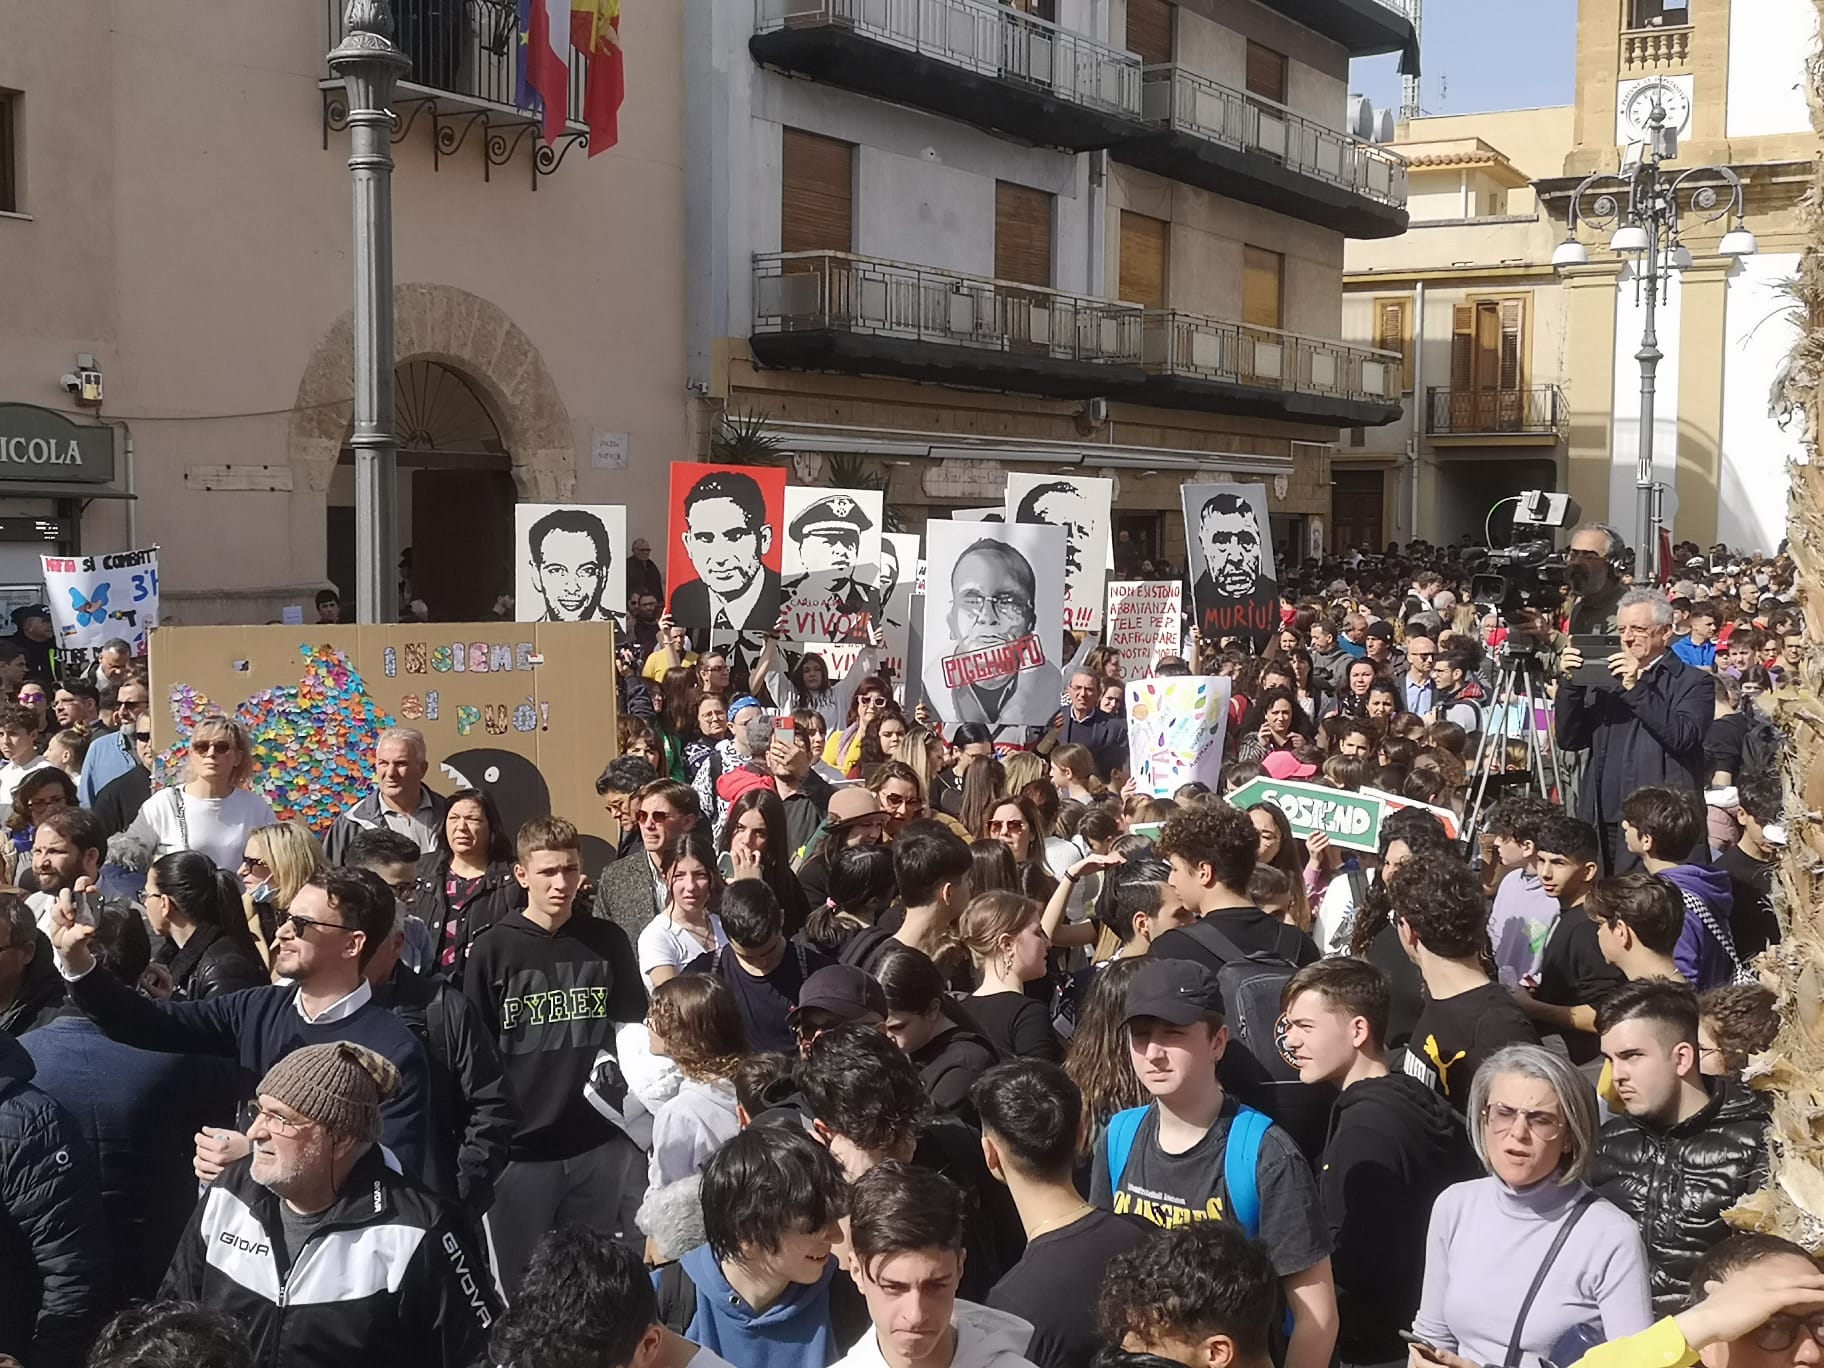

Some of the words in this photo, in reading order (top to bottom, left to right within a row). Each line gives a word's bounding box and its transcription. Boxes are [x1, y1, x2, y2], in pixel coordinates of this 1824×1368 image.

[1110, 586, 1135, 598] NON
[1110, 601, 1176, 615] ABBASTANZA
[1111, 617, 1142, 631] TELE
[384, 641, 534, 678] INSIEME
[401, 690, 439, 720] SI
[503, 987, 608, 1030] PYREX
[442, 1231, 492, 1329] GIVOVA
